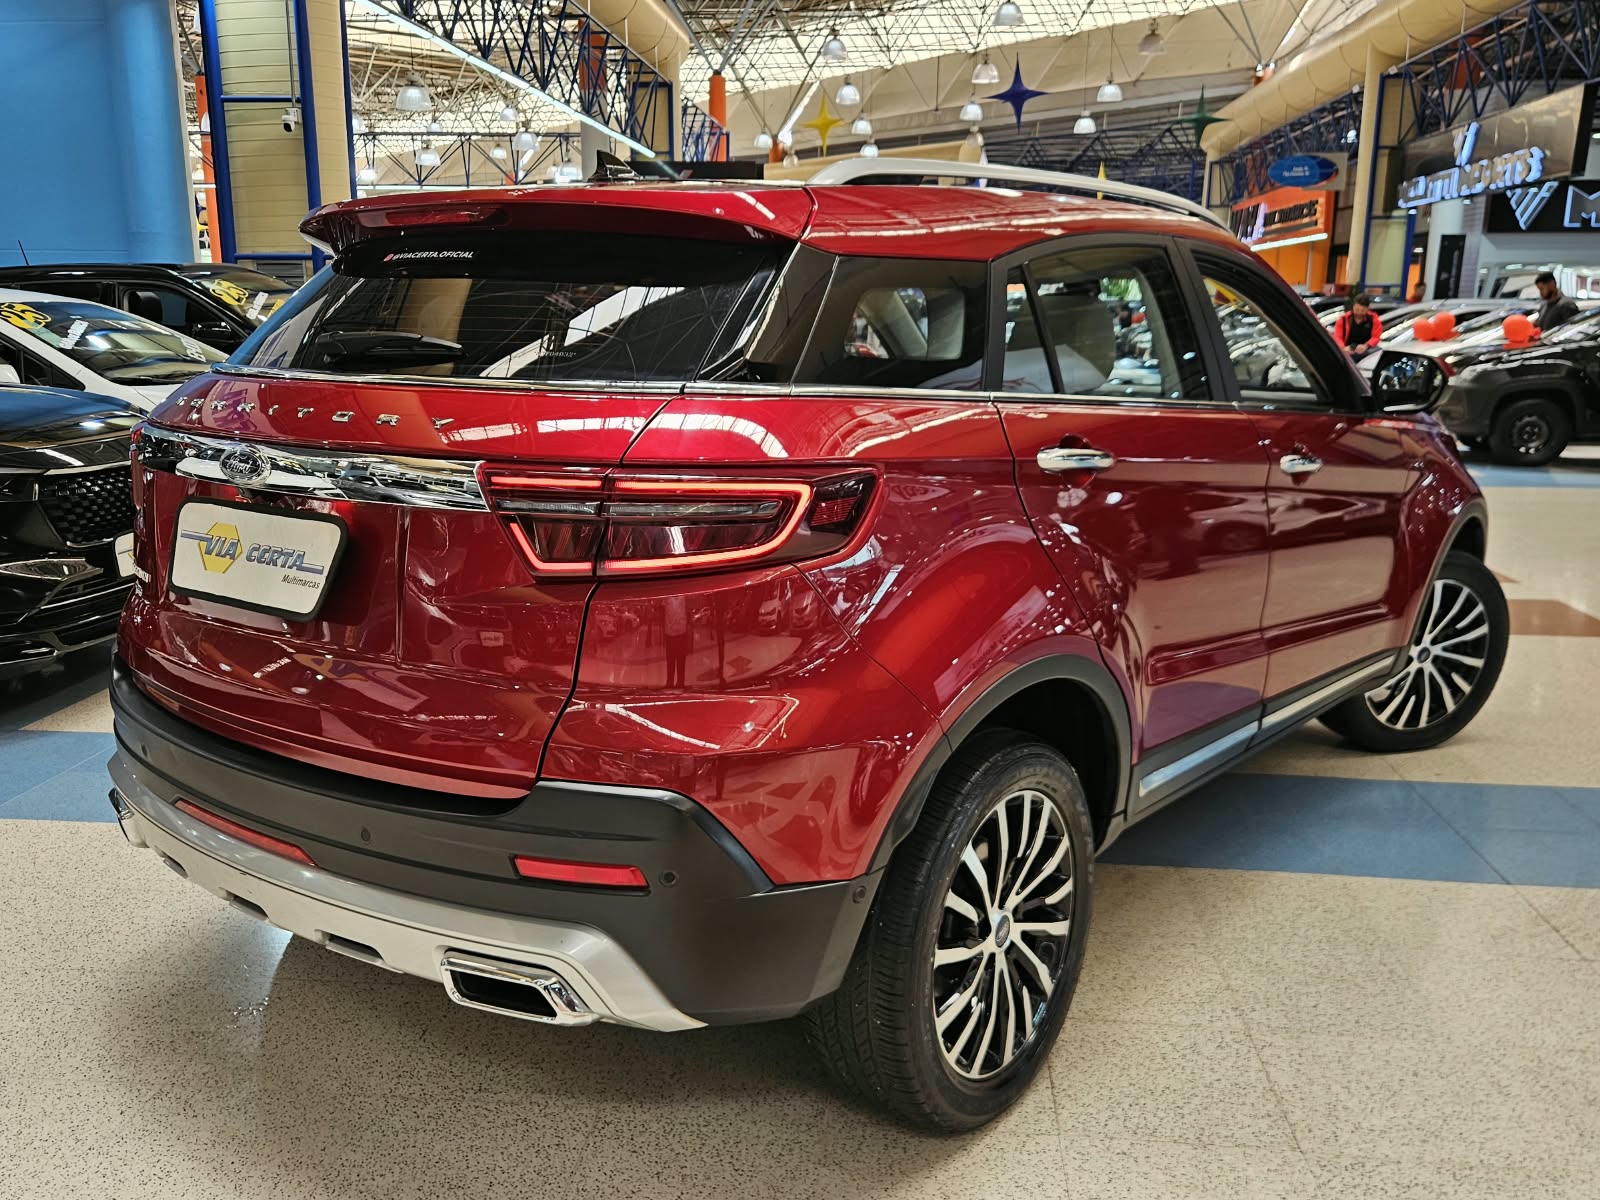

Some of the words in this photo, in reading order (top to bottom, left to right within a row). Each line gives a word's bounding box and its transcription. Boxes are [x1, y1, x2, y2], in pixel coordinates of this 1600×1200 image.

[203, 534, 241, 560] VIA
[246, 542, 306, 571] CERTA
[281, 574, 321, 589] Multimarcas
